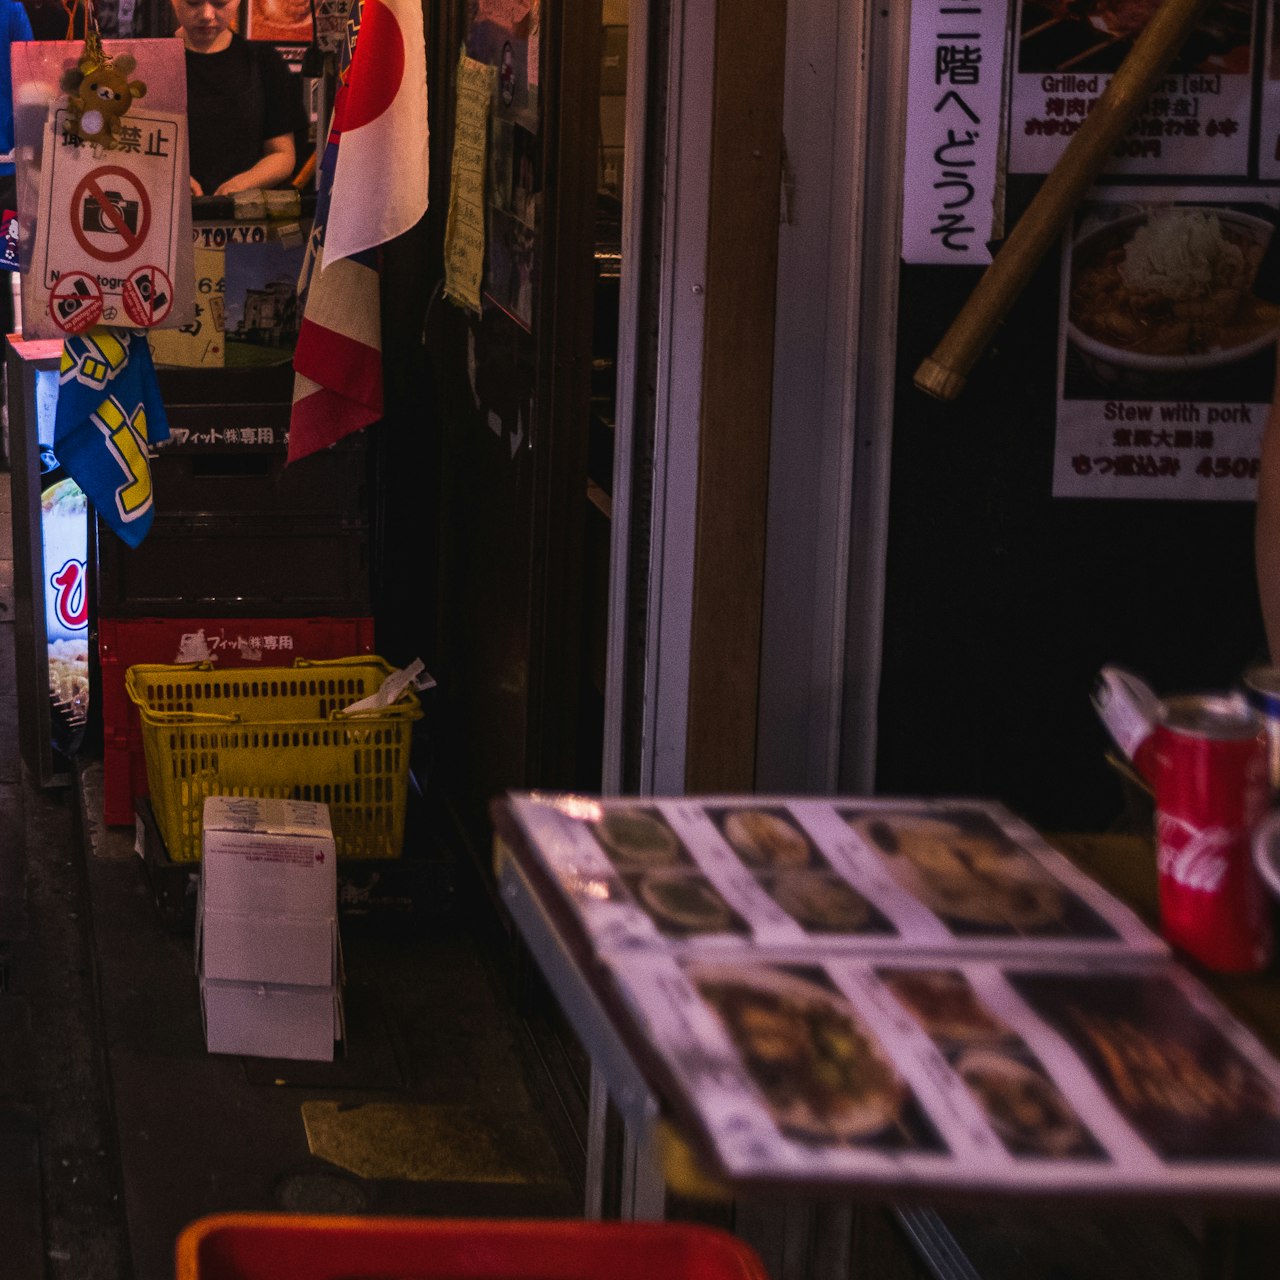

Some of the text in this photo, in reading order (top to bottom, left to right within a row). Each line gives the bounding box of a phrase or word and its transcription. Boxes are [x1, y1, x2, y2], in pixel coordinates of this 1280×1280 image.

[1041, 76, 1098, 94] Grilled
[201, 227, 265, 247] TOKYO
[1104, 402, 1252, 424] Stew with pork
[1071, 454, 1181, 477] もつ煮込み
